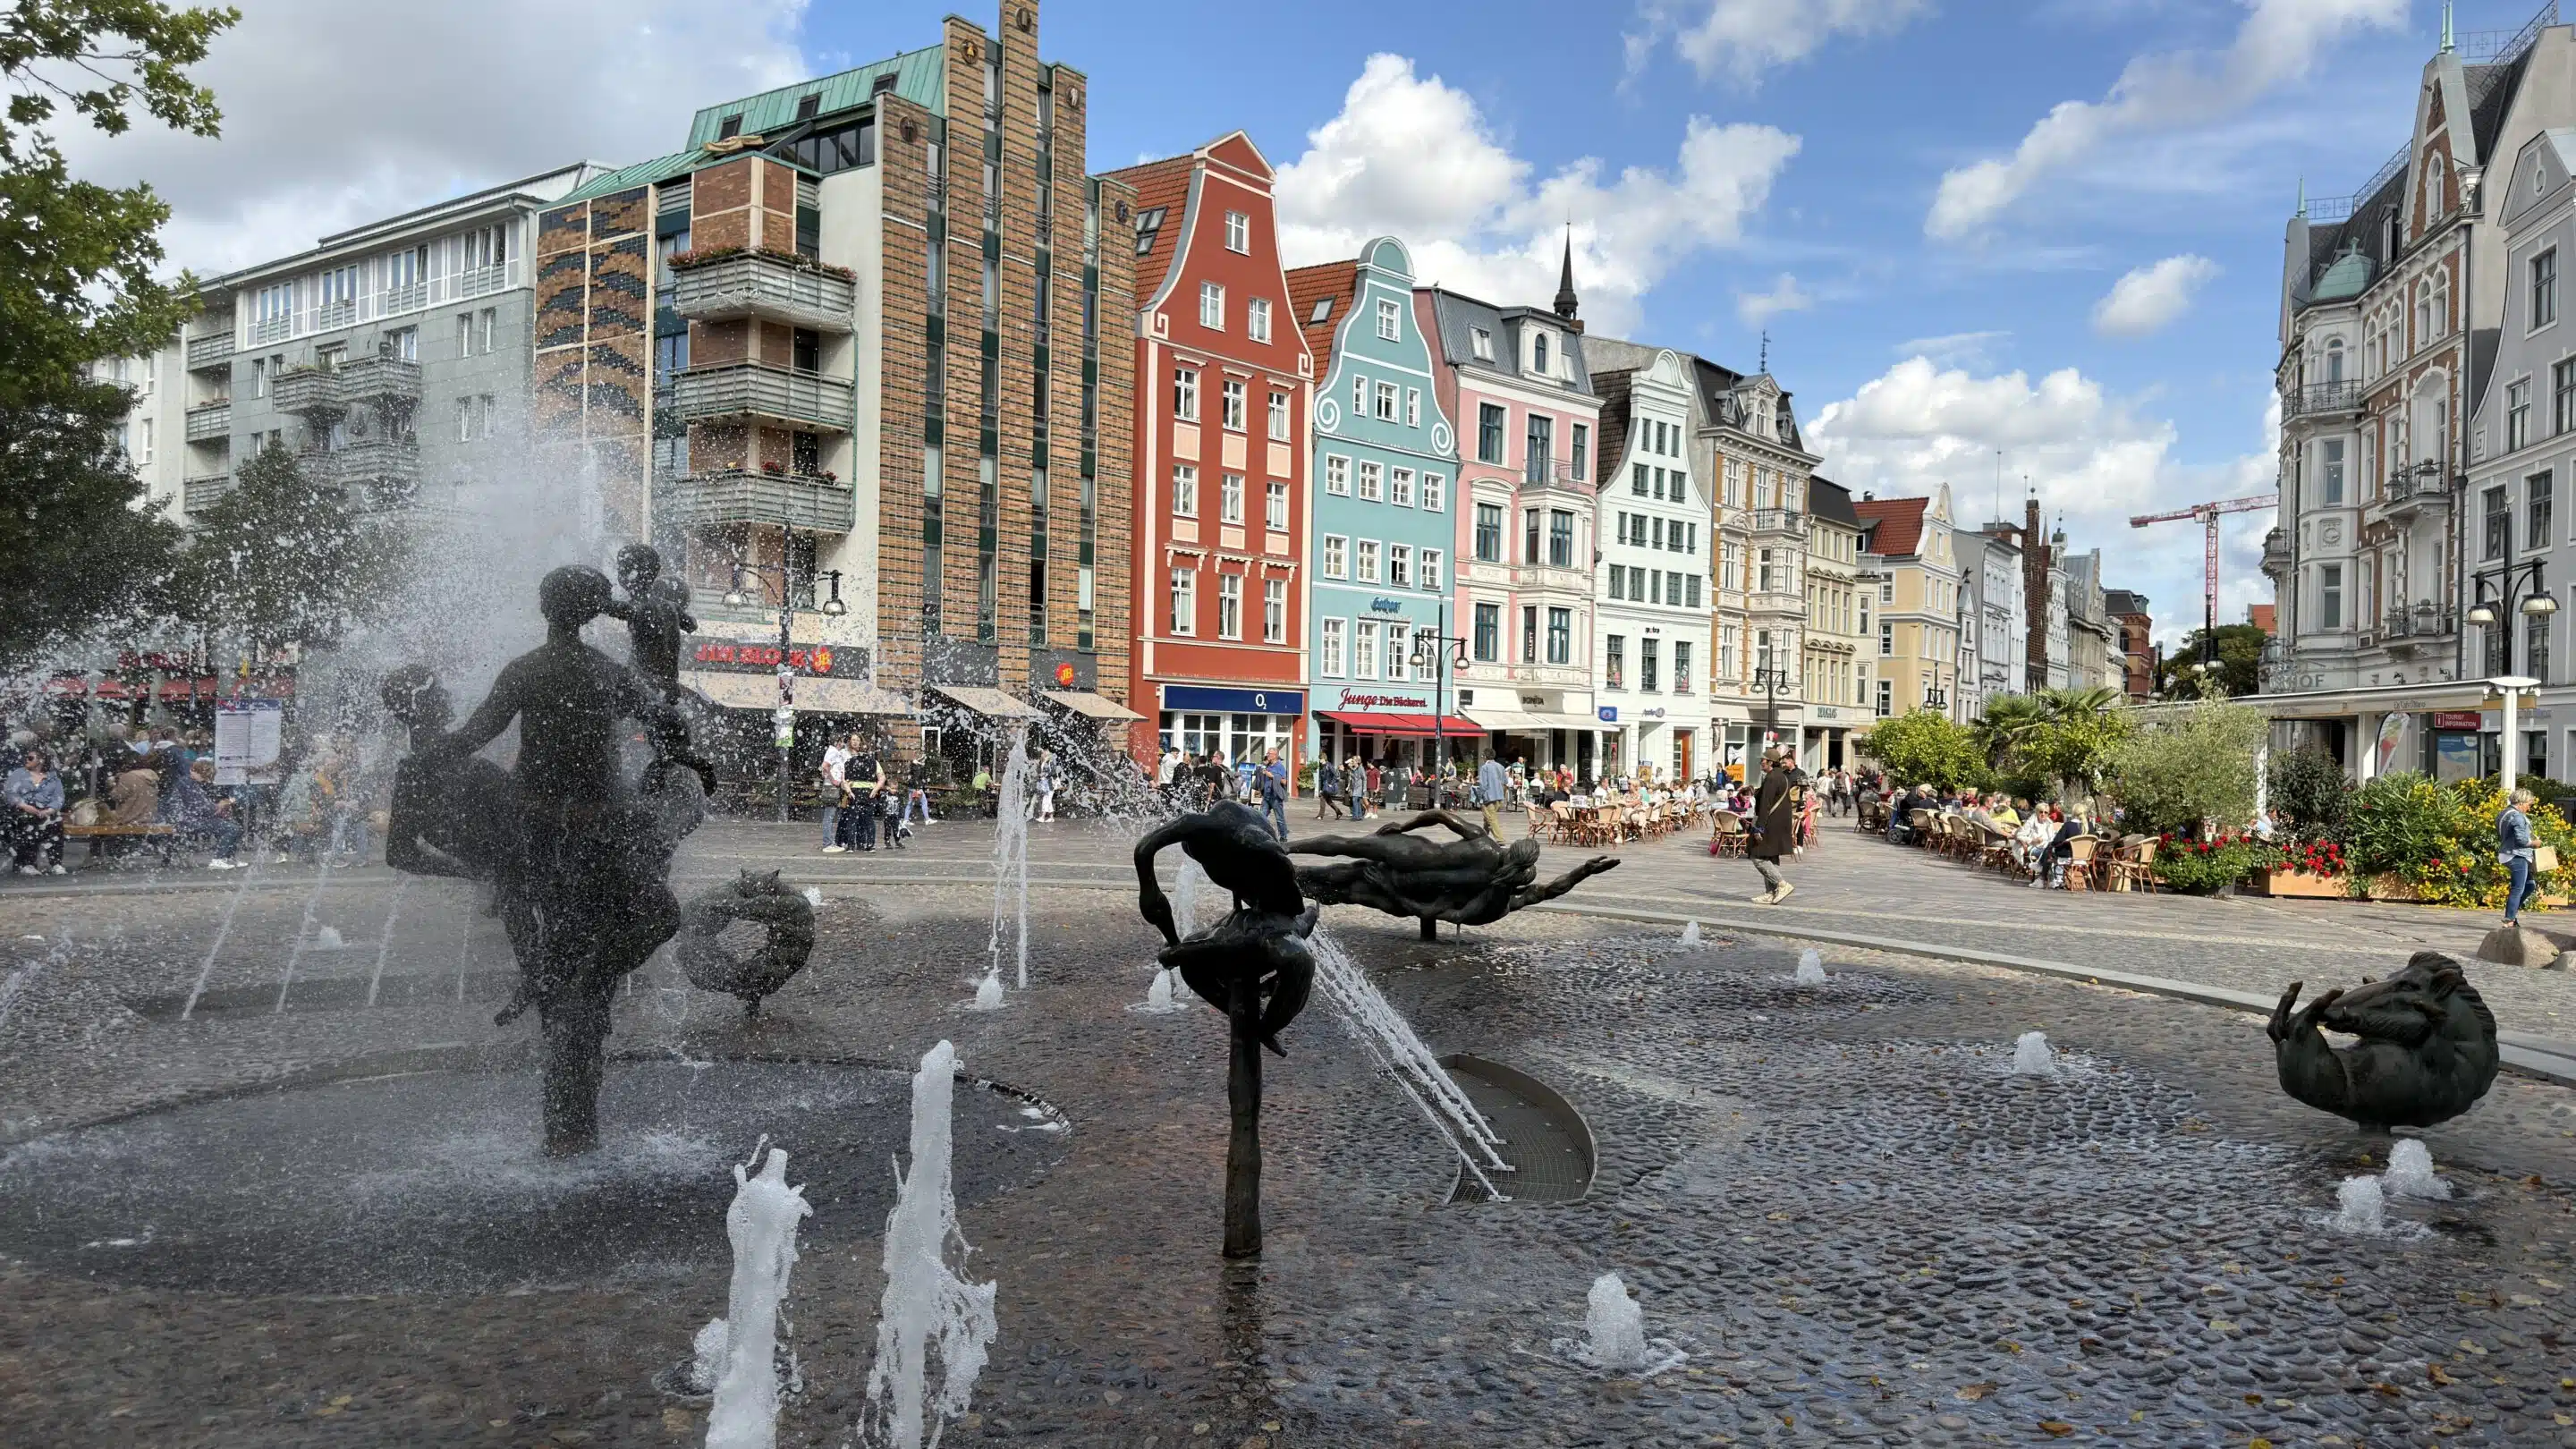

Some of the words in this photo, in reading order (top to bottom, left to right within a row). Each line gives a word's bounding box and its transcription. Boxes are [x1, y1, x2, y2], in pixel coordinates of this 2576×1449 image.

[694, 643, 734, 663] JIM
[739, 646, 807, 667] BLOK
[1338, 688, 1377, 711] Junge
[1379, 695, 1393, 706] Die
[1522, 695, 1544, 705] BONITA
